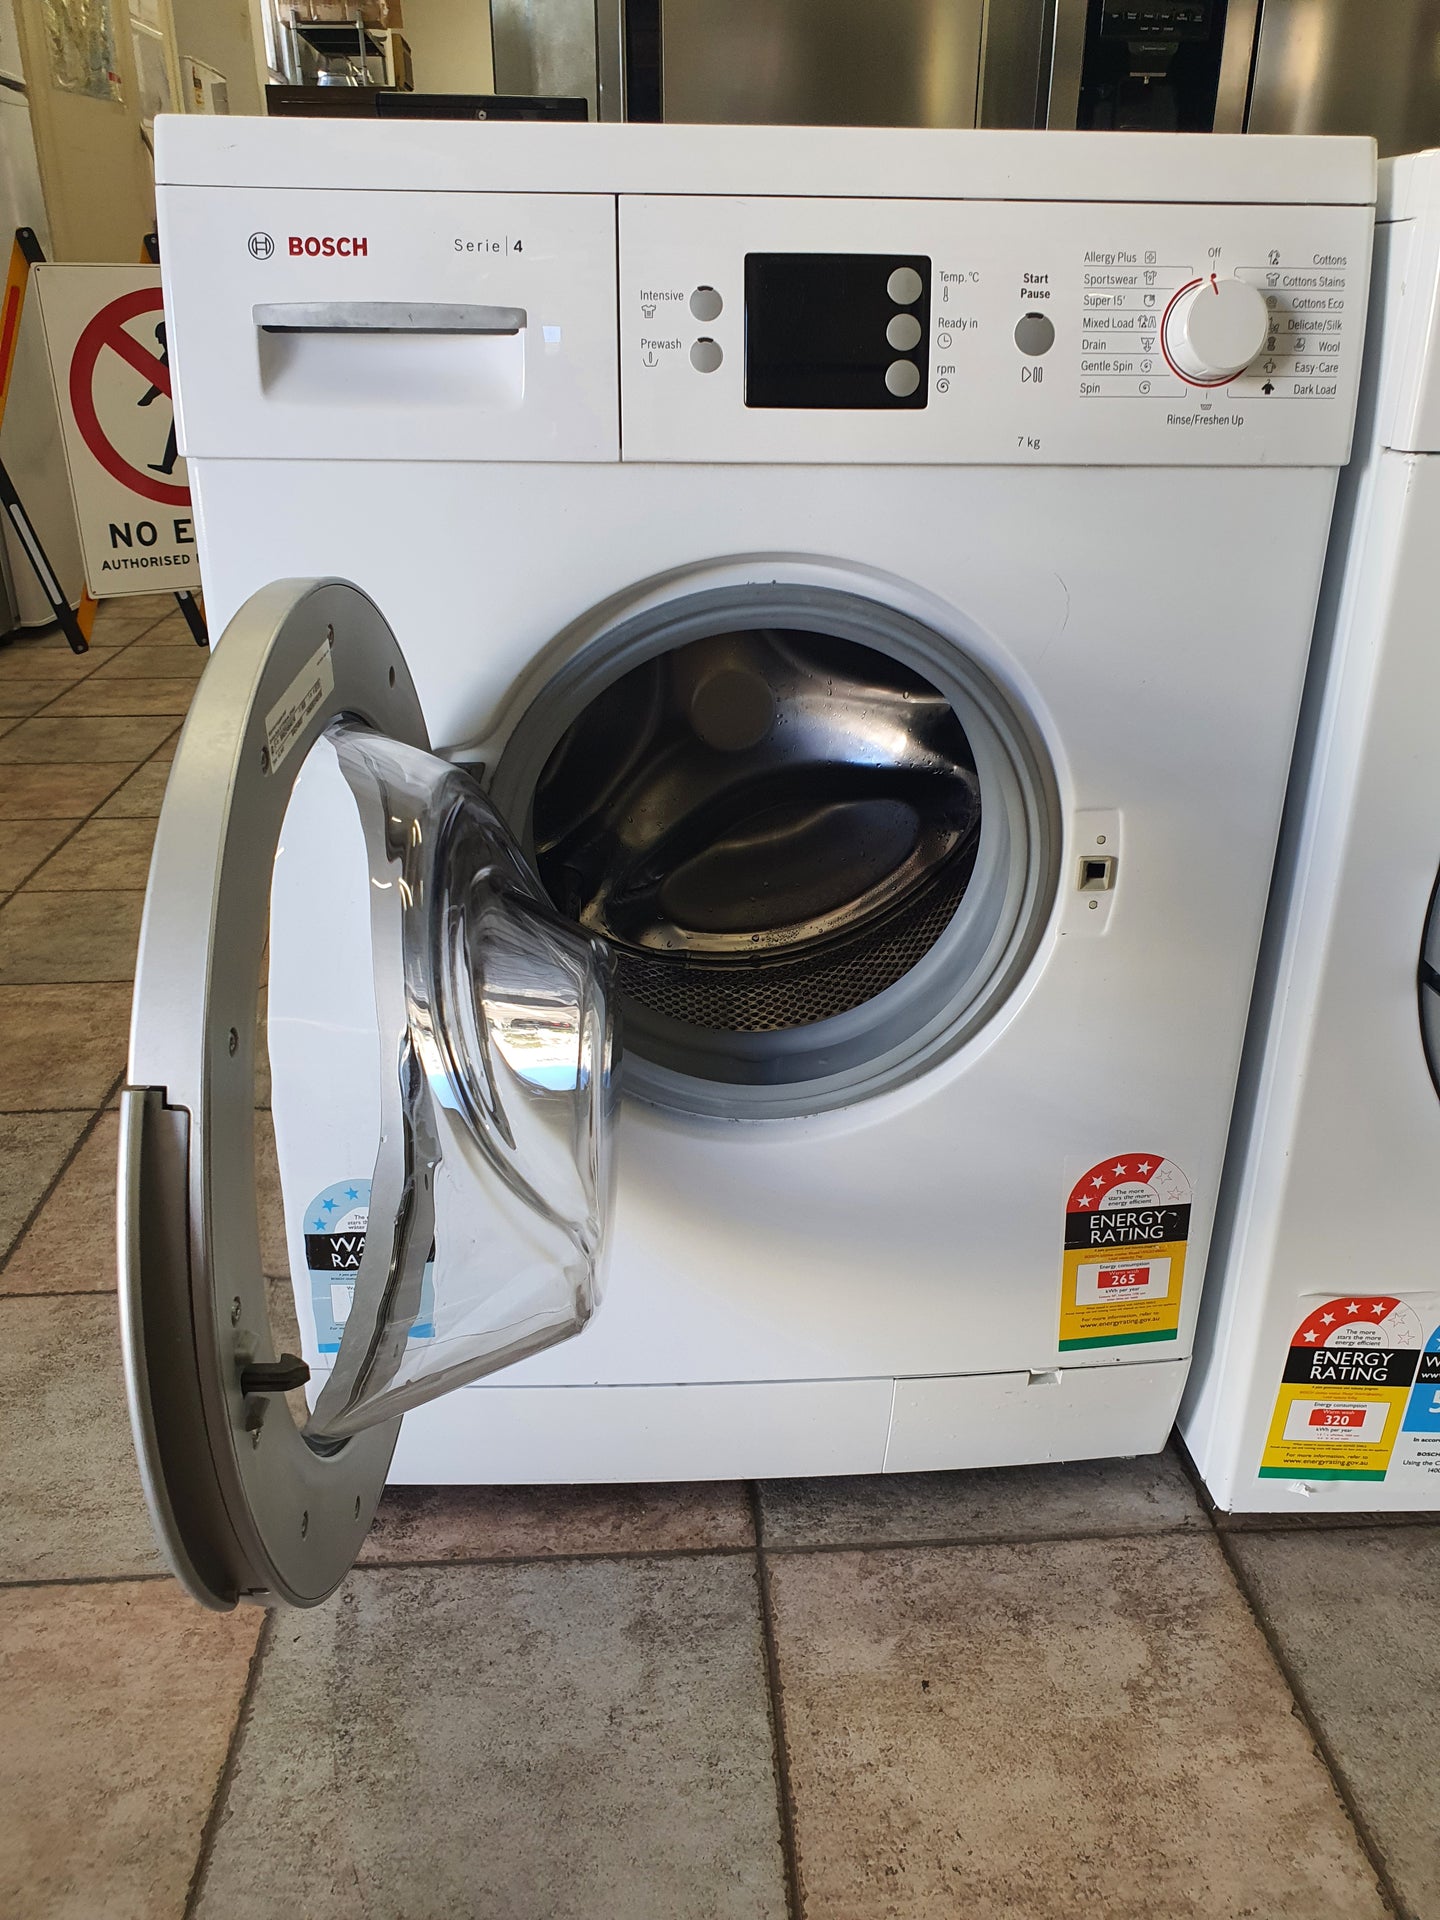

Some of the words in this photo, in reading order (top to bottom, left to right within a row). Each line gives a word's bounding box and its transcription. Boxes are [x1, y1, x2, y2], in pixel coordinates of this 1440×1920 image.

[288, 236, 368, 257] BOSCH
[454, 238, 500, 252] Serie
[513, 239, 523, 253] 4
[1084, 251, 1115, 265] Allergy
[1117, 251, 1137, 263] Plus
[1207, 247, 1222, 258] Off
[1312, 254, 1347, 266] Cottons
[939, 271, 967, 284] Temp.
[1023, 273, 1049, 284] Start
[1084, 273, 1138, 286] Sportswear
[1282, 275, 1317, 287] Cottons
[1319, 276, 1346, 288] Stains
[640, 290, 684, 301] Intensive
[1020, 288, 1051, 299] Pause
[1083, 295, 1111, 308] Super
[1291, 297, 1326, 309] Cottons
[1327, 298, 1345, 309] Eco
[938, 317, 966, 331] Ready
[969, 317, 978, 328] in
[1082, 317, 1110, 328] Mixed
[1112, 317, 1134, 328] Load
[1287, 319, 1343, 332] Delicate/Silk
[640, 338, 682, 349] Prewash
[1082, 339, 1107, 350] Drain
[1318, 338, 1341, 352] Wool
[936, 364, 956, 375] rpm
[1080, 358, 1111, 371] Gentle
[1112, 359, 1133, 373] Spin
[1294, 362, 1339, 375] Easy-Care
[1079, 382, 1101, 394] Spin
[1293, 384, 1314, 395] Dark
[1315, 384, 1337, 395] Load
[1166, 413, 1230, 426] Rinse/Freshen
[1231, 414, 1244, 427] Up
[1017, 436, 1024, 447] 7
[1027, 436, 1041, 450] kg
[109, 521, 158, 549] NO
[173, 518, 194, 544] E
[101, 554, 191, 571] AUTHORISED
[1090, 1210, 1167, 1229] ENERGY
[1090, 1225, 1164, 1244] RATING
[330, 1236, 366, 1252] WA
[331, 1253, 363, 1268] RA
[1111, 1273, 1136, 1286] 265
[1079, 1316, 1160, 1329] www.energyrating.gov.au
[1312, 1350, 1395, 1367] ENERGY
[1425, 1355, 1440, 1367] W
[1309, 1366, 1389, 1382] RATING
[1323, 1415, 1350, 1426] 320
[1283, 1458, 1369, 1466] www.energyrating.gov.au
